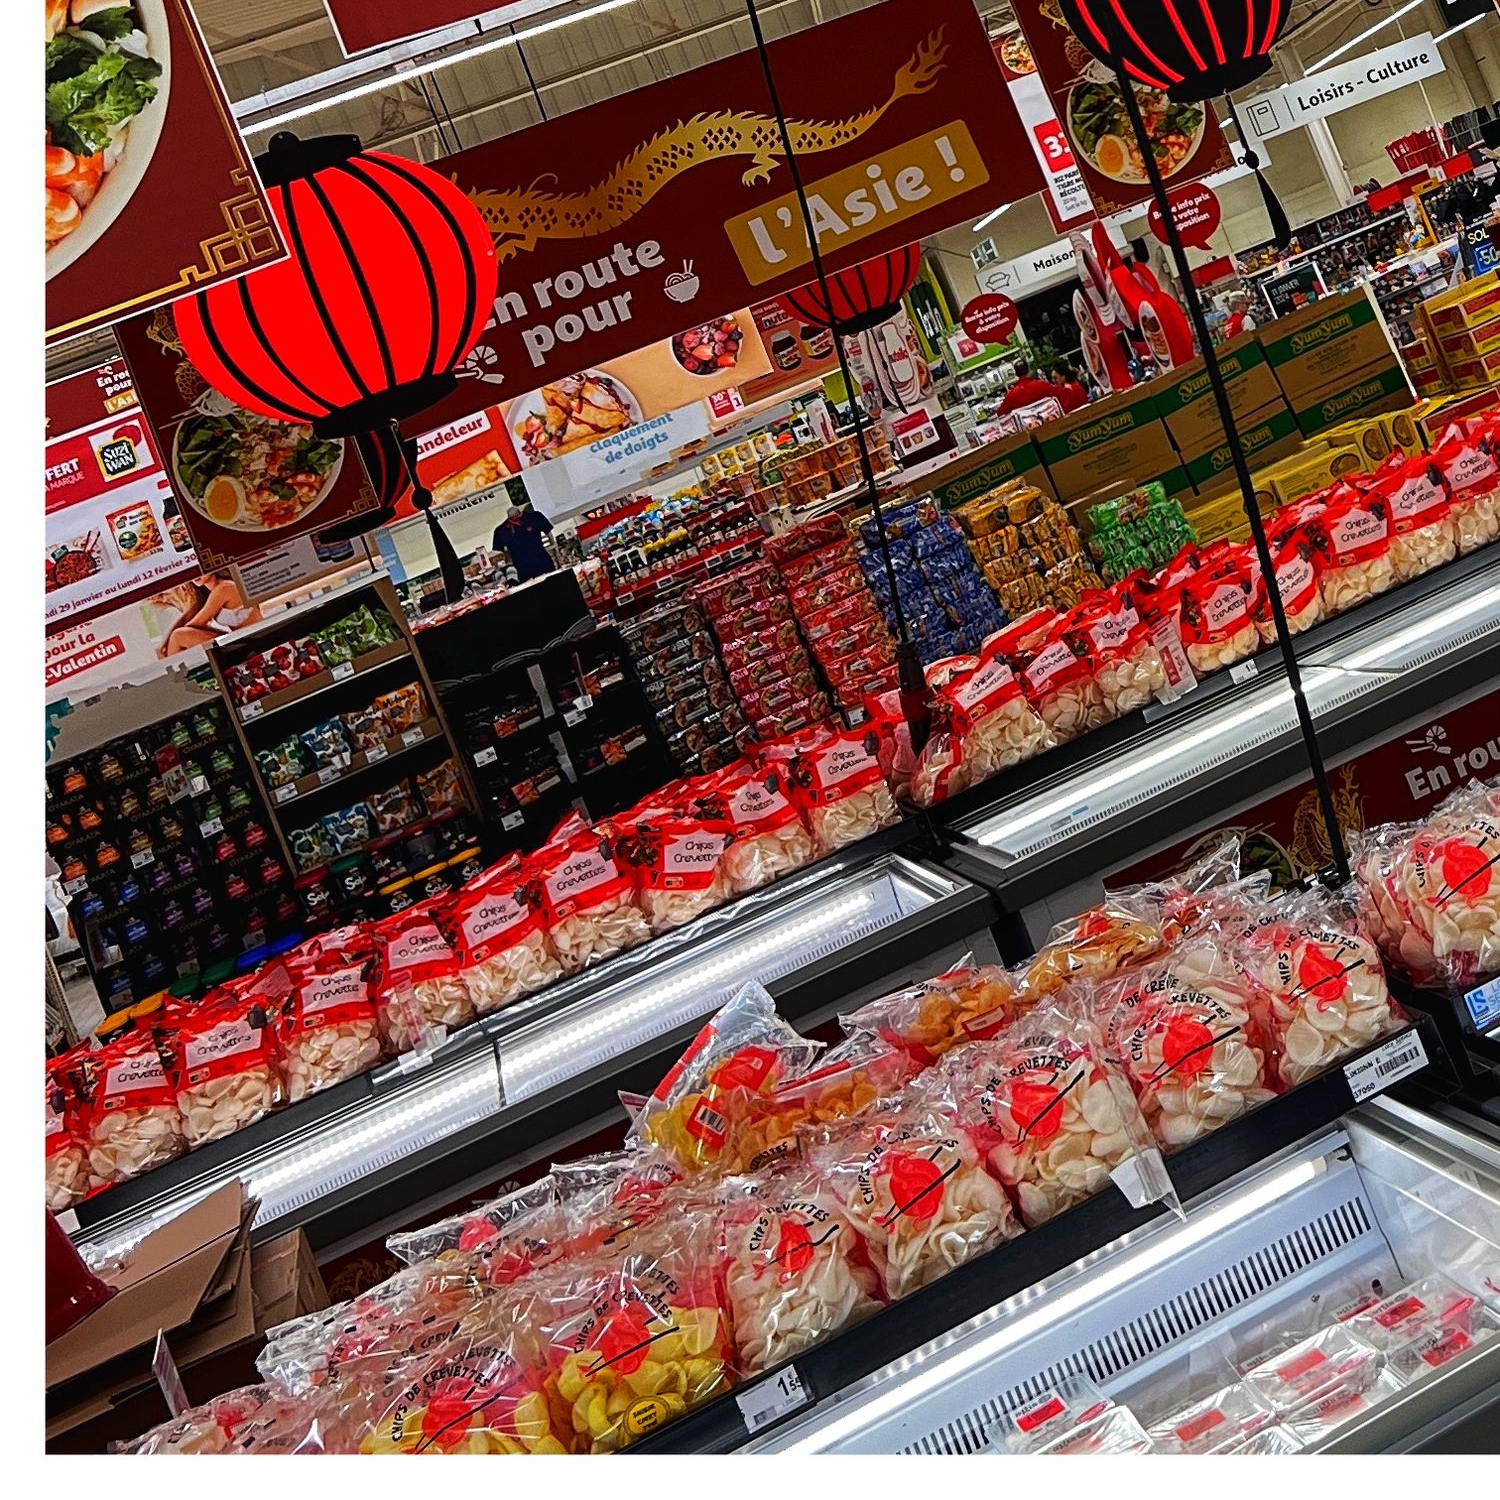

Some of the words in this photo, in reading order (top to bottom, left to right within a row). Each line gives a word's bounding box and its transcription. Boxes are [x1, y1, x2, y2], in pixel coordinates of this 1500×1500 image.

[1297, 81, 1354, 112] Loisirs
[1366, 51, 1431, 86] Culture
[748, 164, 933, 264] l'Asie
[935, 135, 966, 183] !
[1176, 198, 1194, 213] info
[1194, 192, 1211, 208] prix
[530, 240, 665, 303] route
[1034, 250, 1076, 272] Maison
[521, 287, 634, 367] pour
[1292, 314, 1352, 354] YumYum
[1322, 380, 1384, 420] YumYum
[590, 413, 674, 455] claquement
[604, 449, 624, 466] de
[624, 431, 670, 459] doigts
[1068, 411, 1134, 453] YumYum
[50, 473, 85, 490] MARQUE
[948, 459, 1014, 501] YumYum
[60, 604, 71, 614] 29
[72, 591, 104, 609] janvier
[104, 588, 117, 597] au
[117, 574, 141, 593] lundi
[143, 571, 155, 581] 12
[155, 560, 184, 577] février
[79, 632, 95, 647] la
[1404, 759, 1452, 801] En
[563, 859, 592, 876] Chips
[857, 1165, 873, 1205] CHIPS
[574, 1314, 596, 1355] CHIPS
[595, 1299, 609, 1316] DE
[391, 1401, 410, 1442] CHIPS
[405, 1381, 423, 1400] DE
[423, 1364, 493, 1389] CREVETTES
